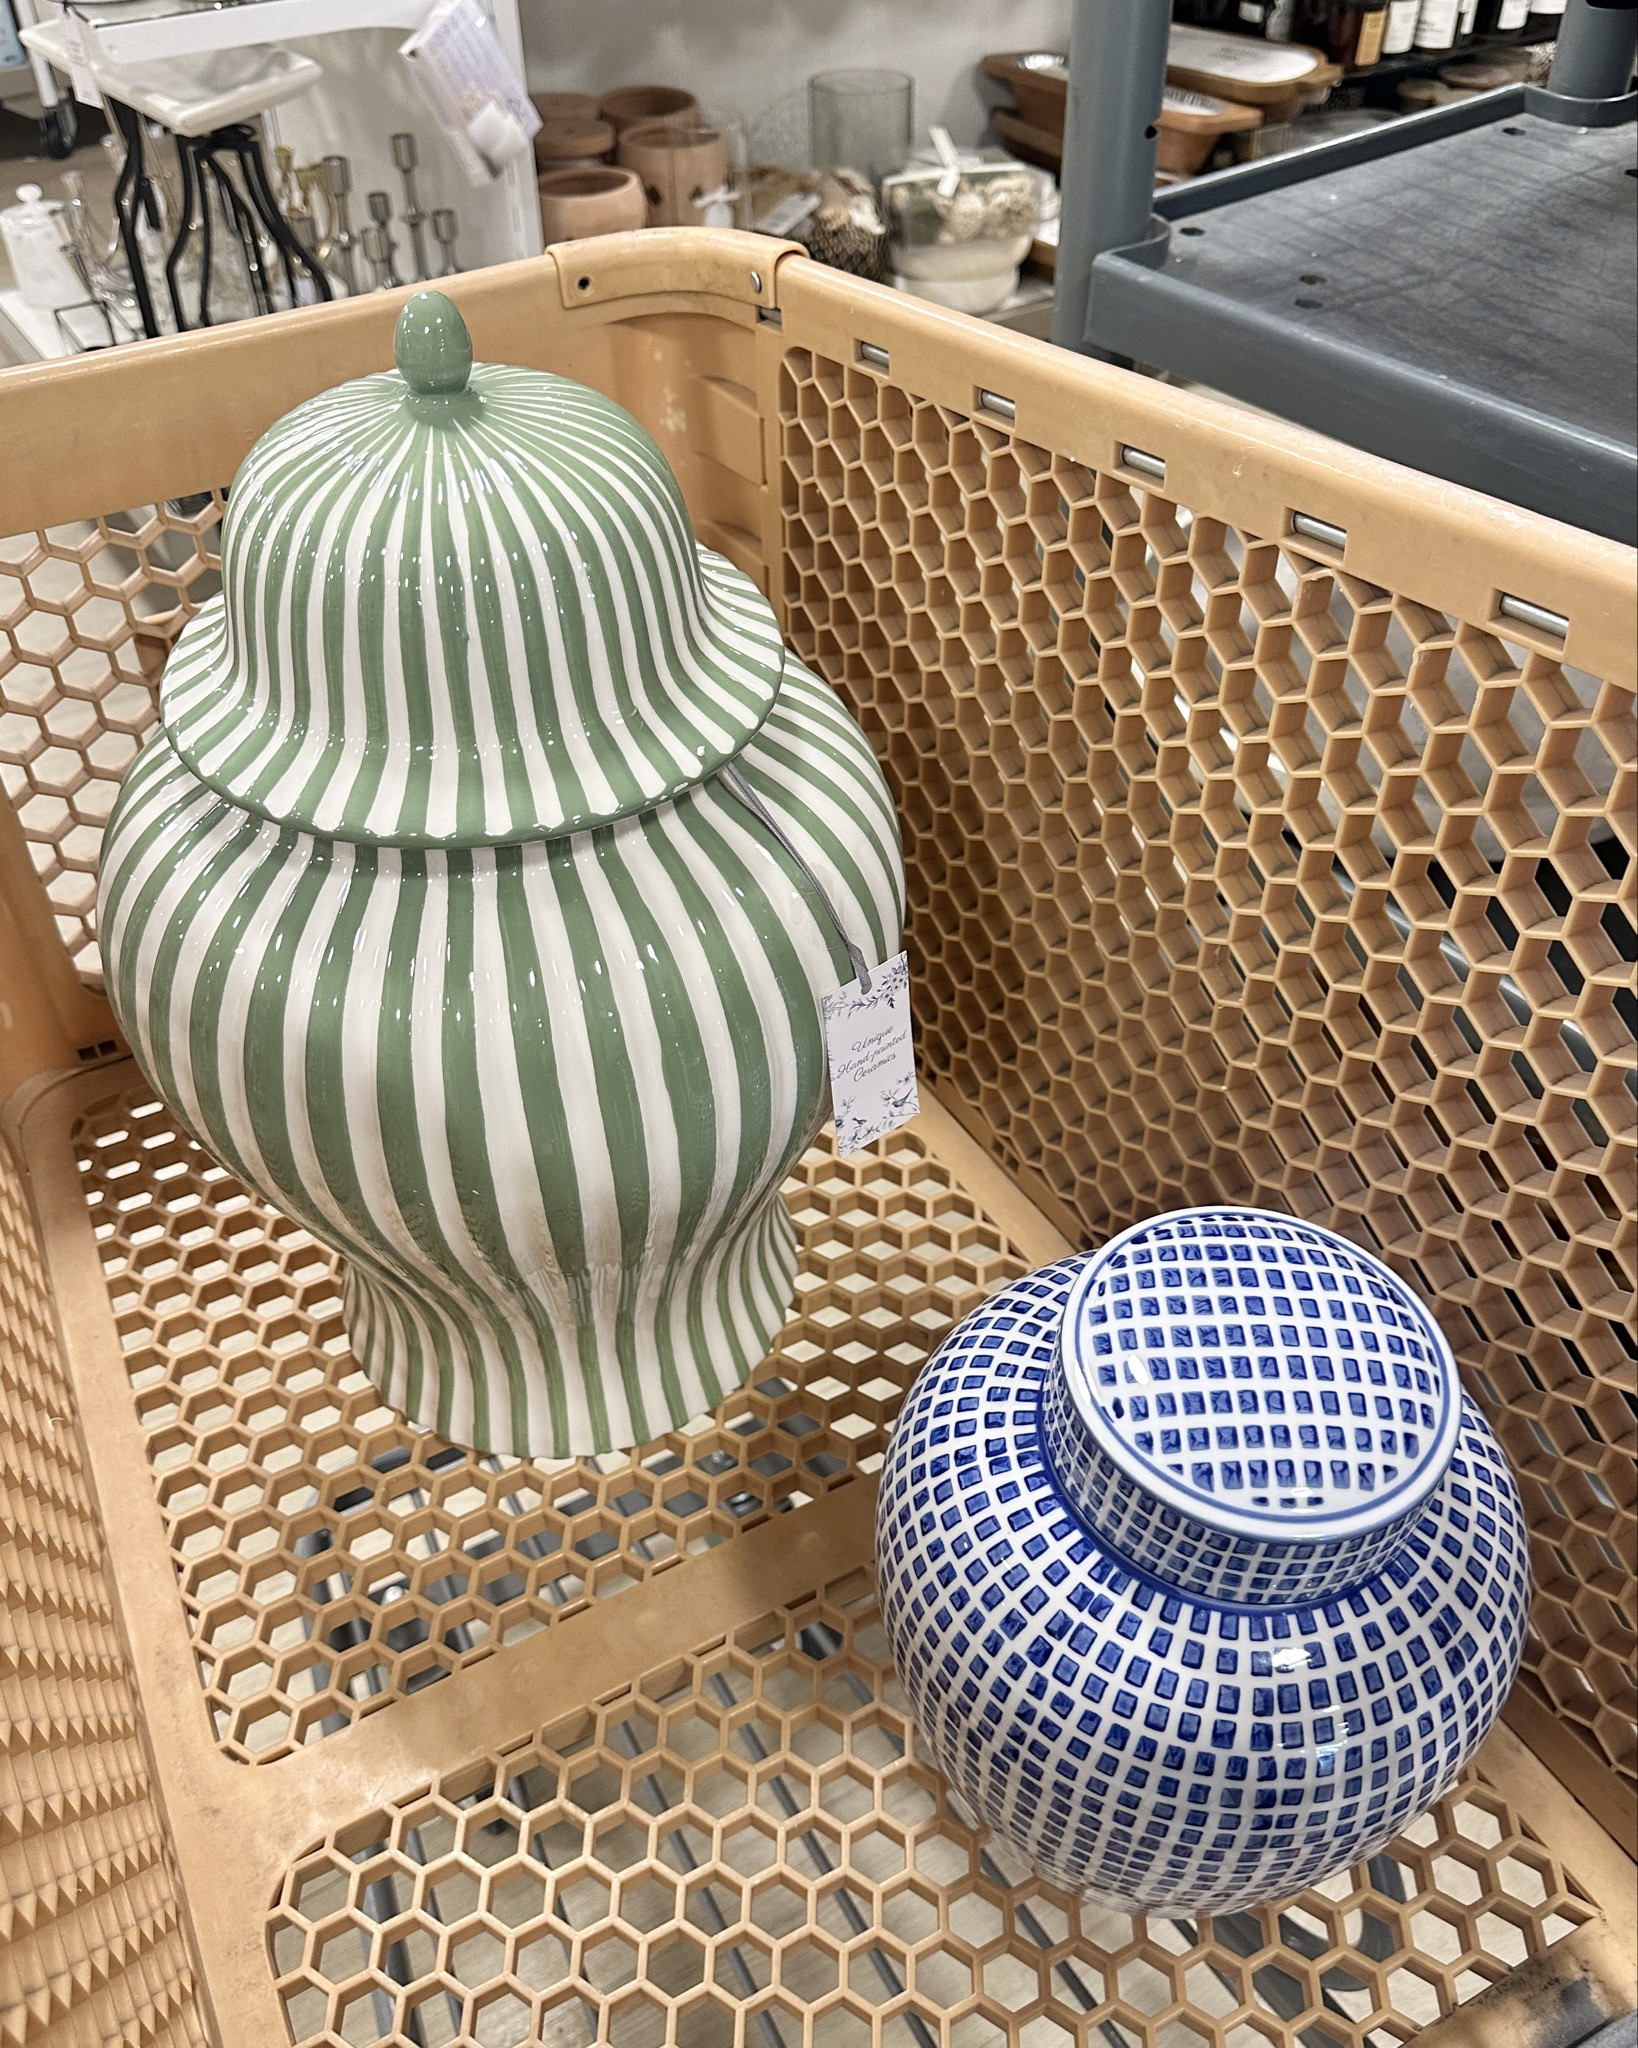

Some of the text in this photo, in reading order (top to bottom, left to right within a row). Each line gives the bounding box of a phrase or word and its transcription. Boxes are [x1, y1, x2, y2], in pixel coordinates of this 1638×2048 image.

[837, 1029, 908, 1079] Hand-painted
[851, 1026, 894, 1053] Unique
[853, 1053, 896, 1082] Ceramics
